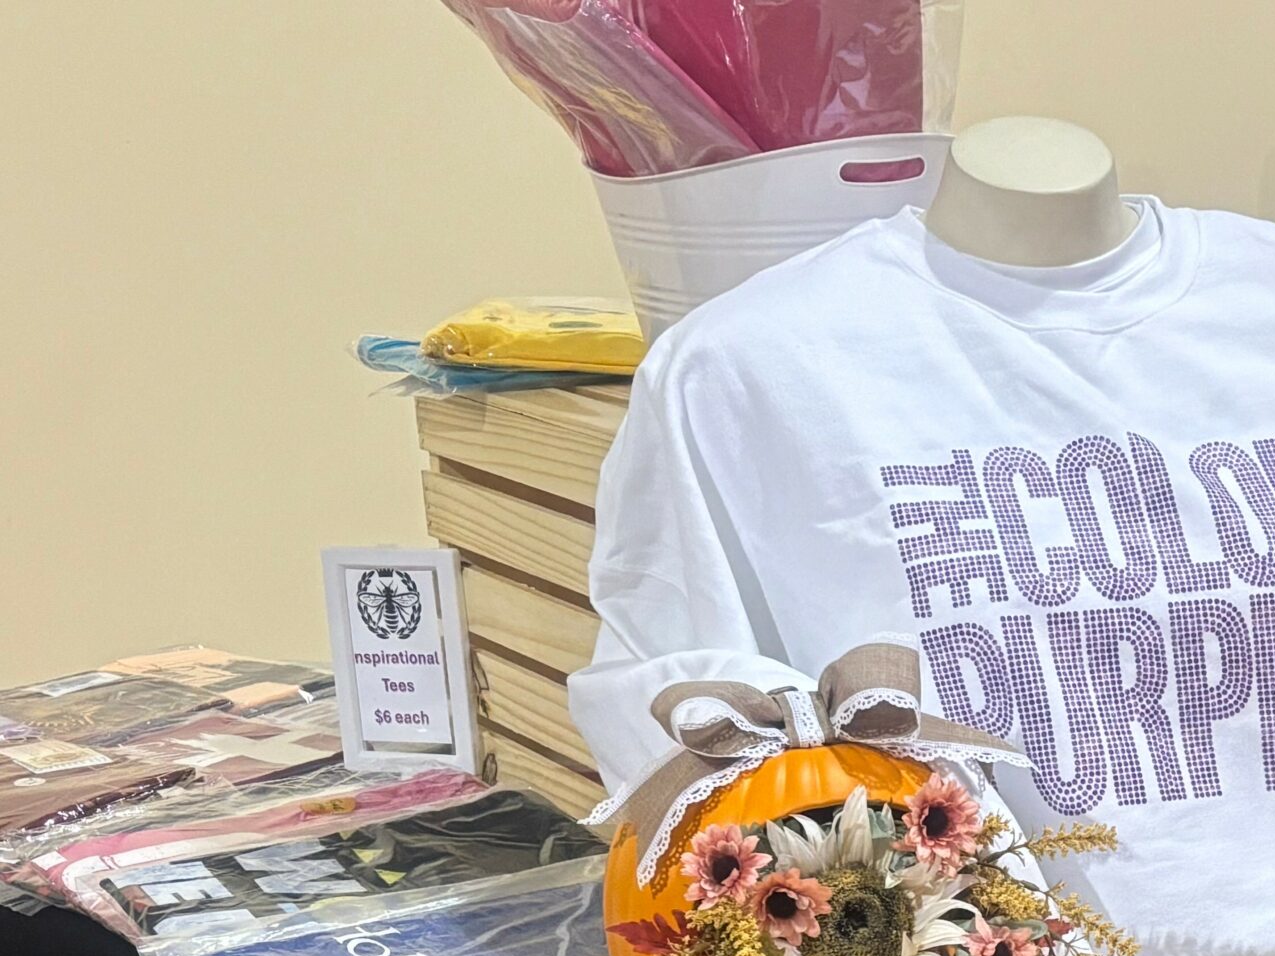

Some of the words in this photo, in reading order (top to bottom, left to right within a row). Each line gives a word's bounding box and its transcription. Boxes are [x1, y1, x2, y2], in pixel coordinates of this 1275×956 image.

[880, 448, 1009, 618] THE
[354, 650, 440, 668] nspirational
[381, 678, 415, 693] Tees
[374, 708, 392, 726] $6
[394, 710, 430, 726] each
